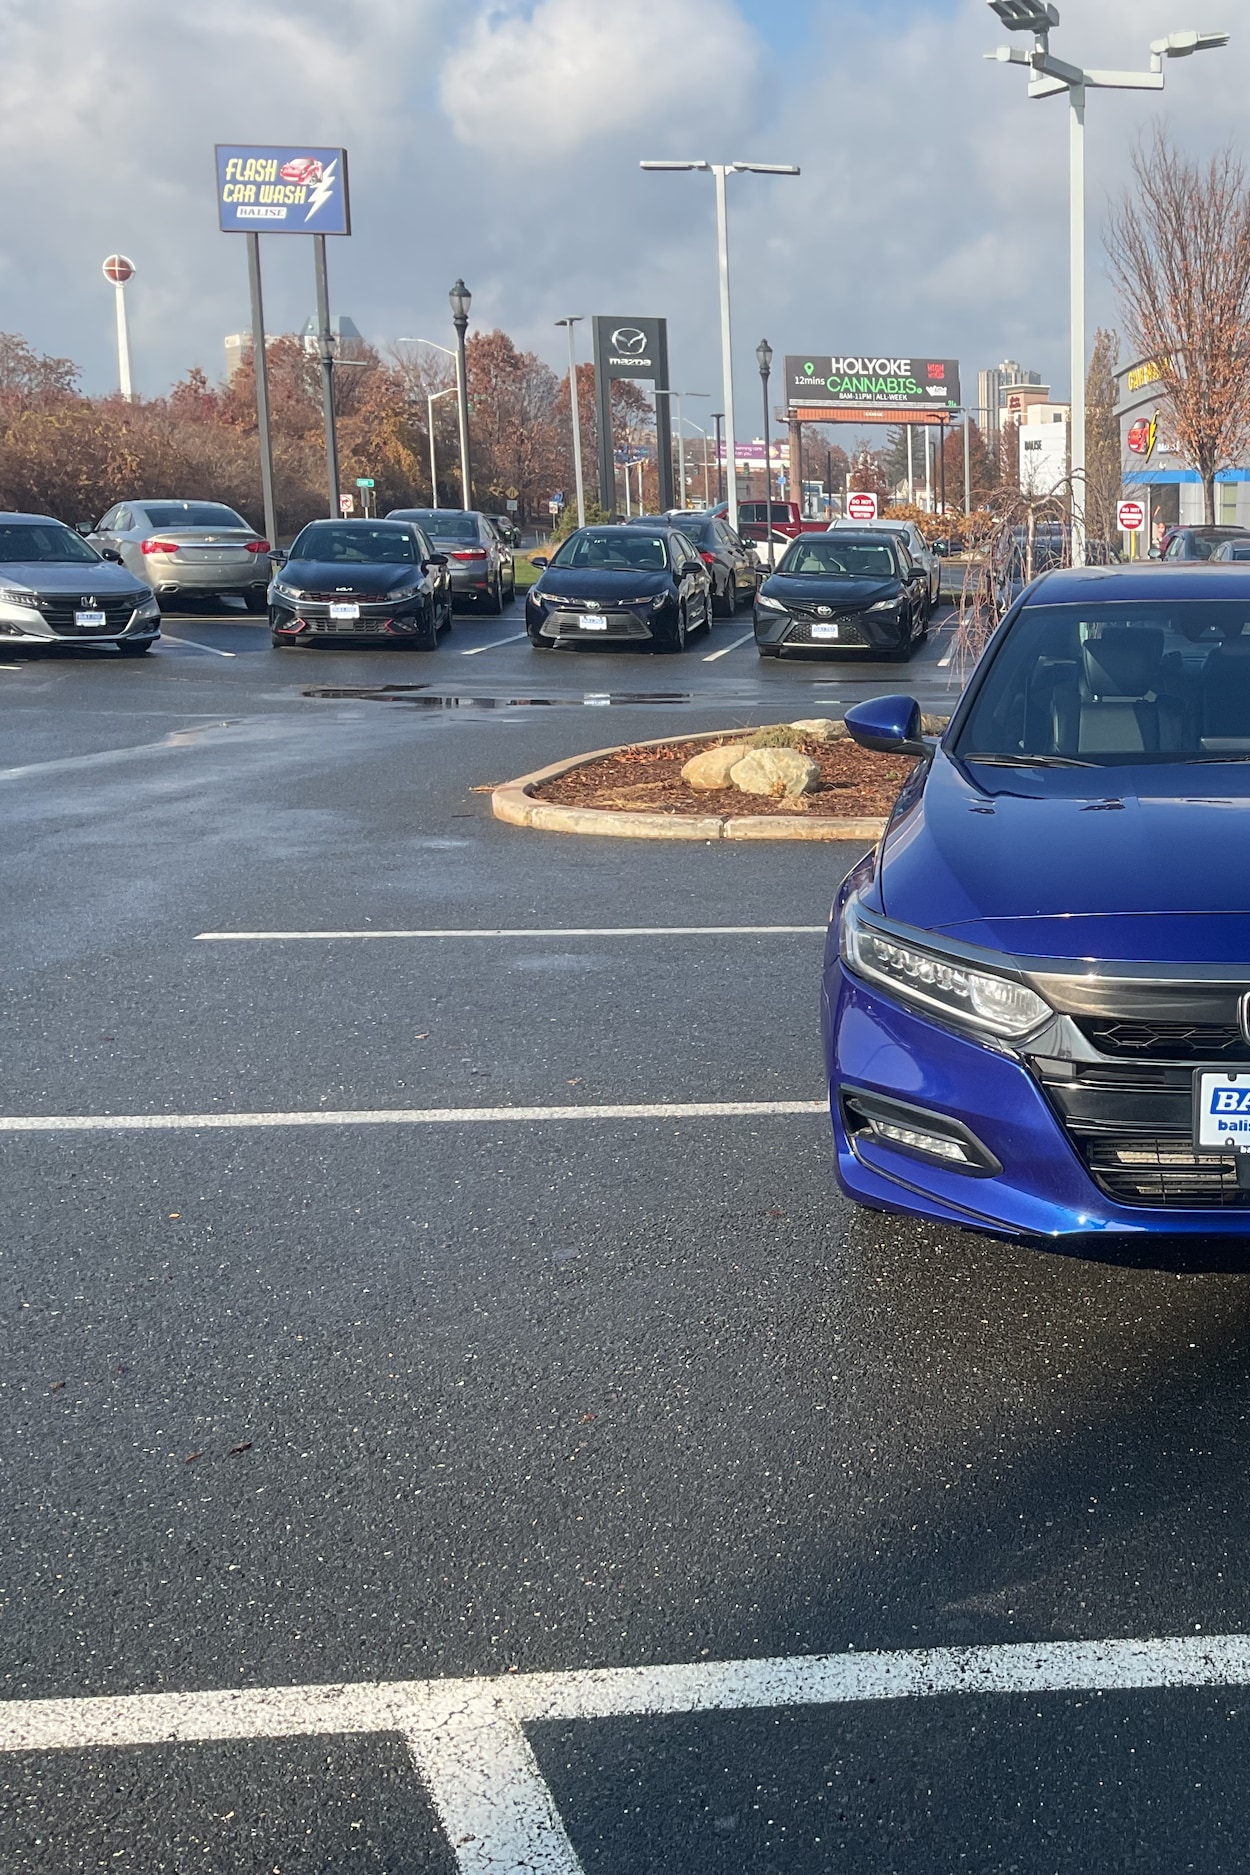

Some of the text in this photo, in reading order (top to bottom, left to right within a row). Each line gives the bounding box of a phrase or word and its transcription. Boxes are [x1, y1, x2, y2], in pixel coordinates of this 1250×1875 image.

[225, 158, 278, 182] FLASH
[222, 183, 307, 204] CAR WASH
[239, 207, 285, 217] BALISE
[831, 357, 911, 376] HOLYOKE
[794, 376, 826, 386] 12mins
[838, 392, 908, 401] 8AM-11PM ALL-WEEK
